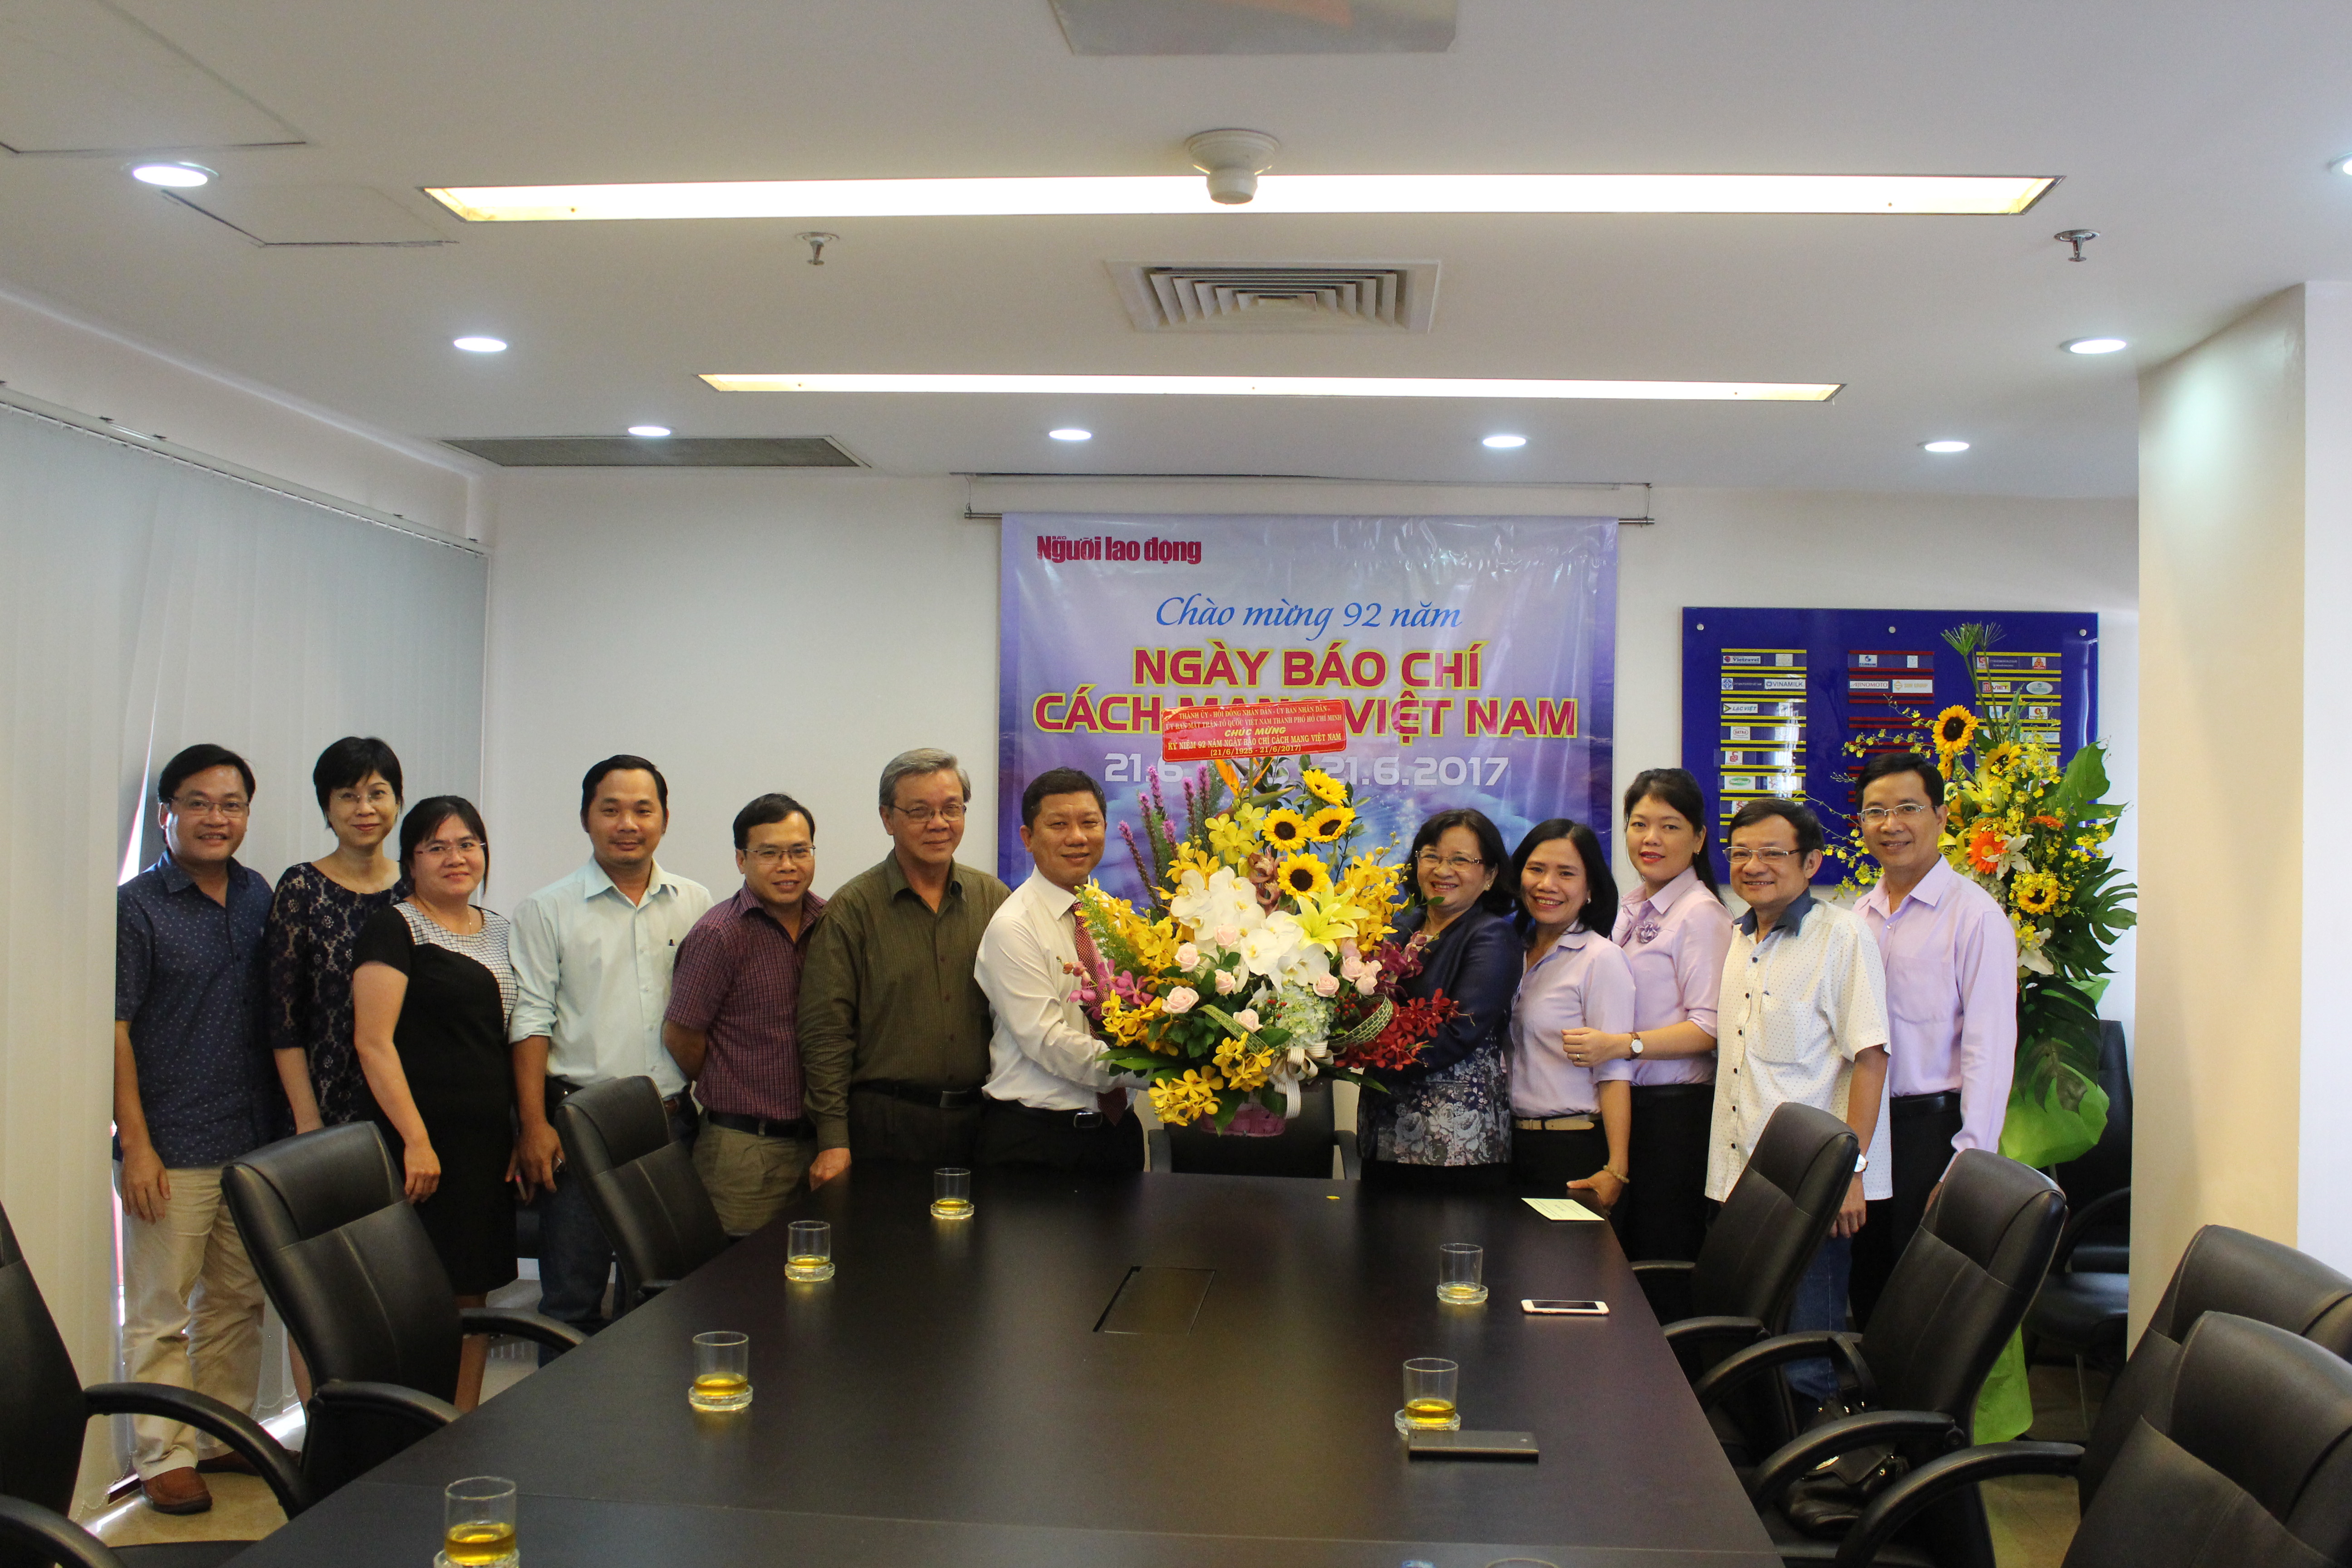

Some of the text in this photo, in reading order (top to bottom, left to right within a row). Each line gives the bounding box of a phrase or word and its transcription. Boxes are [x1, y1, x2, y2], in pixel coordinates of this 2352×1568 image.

[1037, 535, 1201, 564] Người lao động
[1156, 593, 1462, 641] Chào mừng 92 năm
[1132, 638, 1490, 690] NGÀY BÁO CHÍ
[1033, 683, 1579, 746] CÁCH VIỆT NAM
[1179, 711, 1199, 720] THÀNH
[1200, 710, 1208, 718] ỦY
[1225, 707, 1241, 716] ĐỒNG
[1277, 706, 1284, 714] ỦY
[1298, 705, 1314, 713] NHÂN
[1316, 704, 1327, 712] DÂN
[1228, 718, 1243, 727] QUỐC
[1245, 717, 1258, 726] VIỆT
[1273, 716, 1293, 725] THÀNH
[1294, 714, 1305, 723] PHỐ
[1307, 713, 1315, 723] HỒ
[1317, 713, 1326, 722] CHÍ
[1168, 740, 1177, 750] KỶ
[1179, 740, 1196, 750] NIỆM
[1208, 739, 1222, 748] NĂM
[1224, 737, 1242, 747] NGÀY
[1244, 736, 1256, 746] BÁO
[1258, 735, 1269, 745] CHÍ
[1271, 734, 1289, 745] CÁCH
[1291, 735, 1309, 744] MẠNG
[1311, 732, 1326, 743] VIỆT
[1328, 733, 1342, 741] NAM
[1225, 726, 1286, 737] CHÚC MỪNG
[1210, 747, 1253, 757] (21/6/1925
[1260, 745, 1301, 754] 21/6/2017)
[1321, 756, 1509, 786] 21.6.2017
